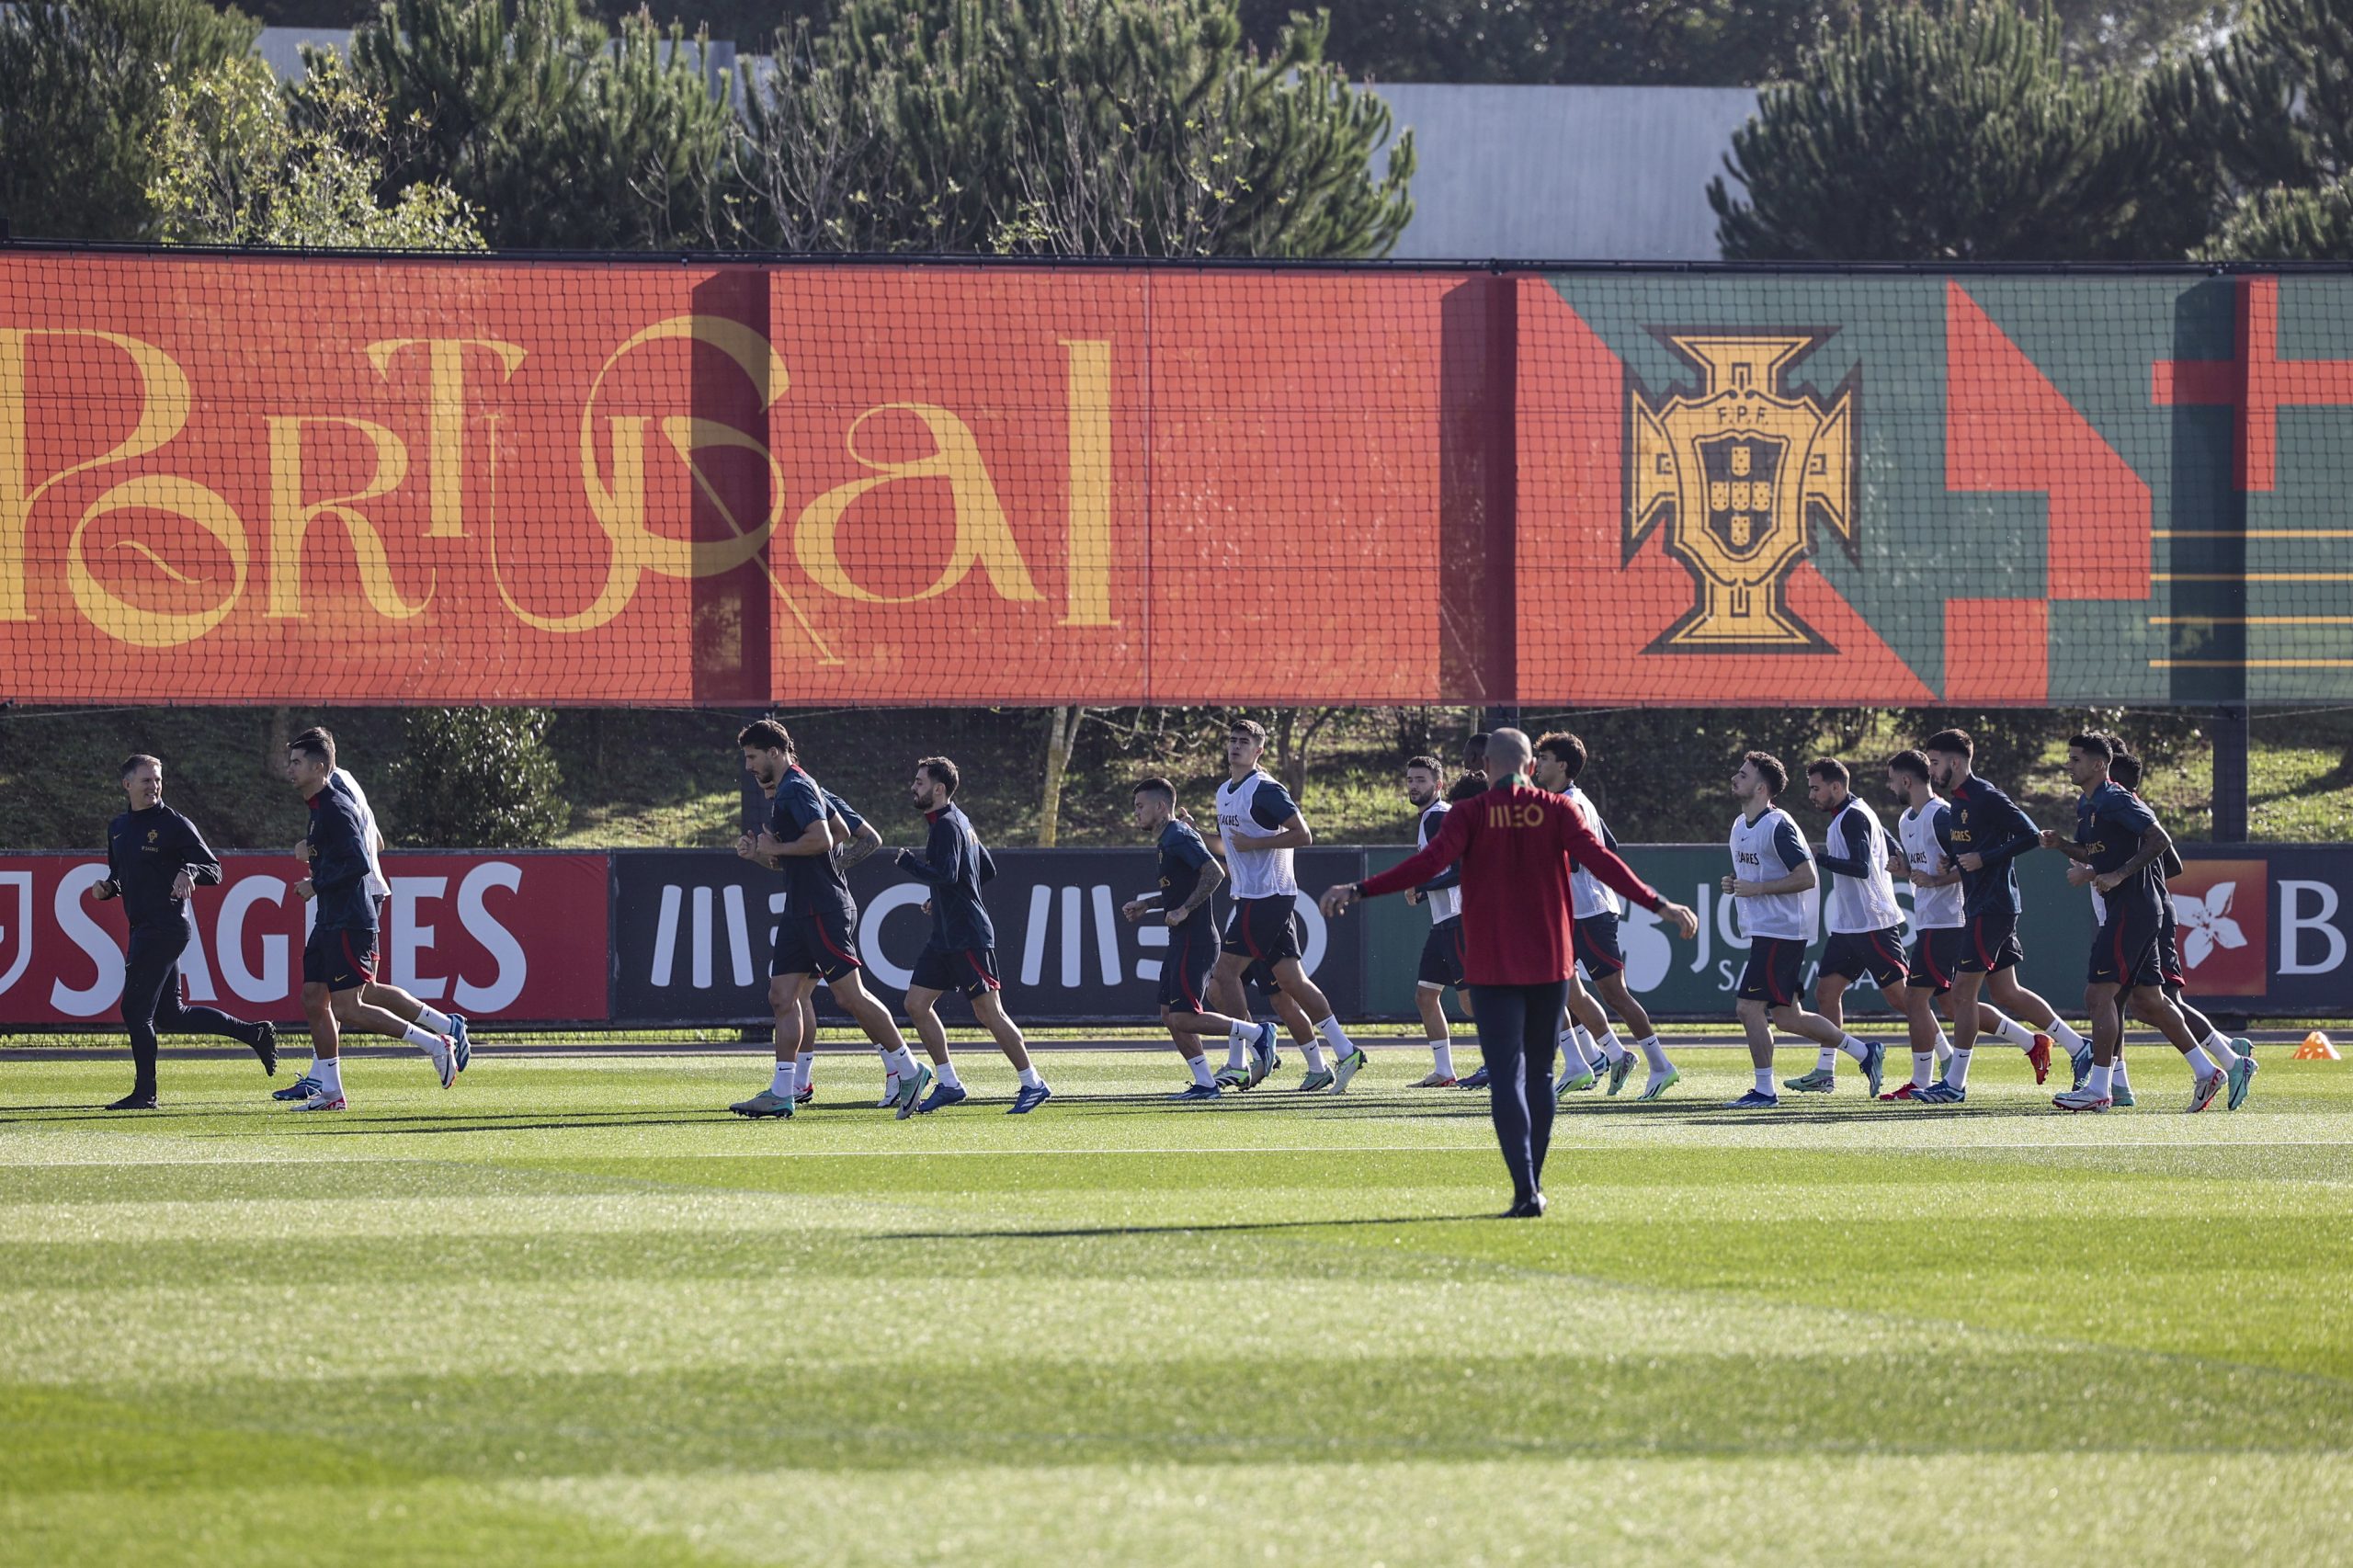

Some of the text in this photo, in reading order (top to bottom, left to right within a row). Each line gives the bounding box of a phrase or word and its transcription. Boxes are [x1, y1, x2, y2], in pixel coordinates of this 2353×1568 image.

[1717, 405, 1768, 426] F.P.F.
[1490, 803, 1544, 828] MEO
[51, 862, 527, 1017] SAGES
[651, 882, 930, 990] MO
